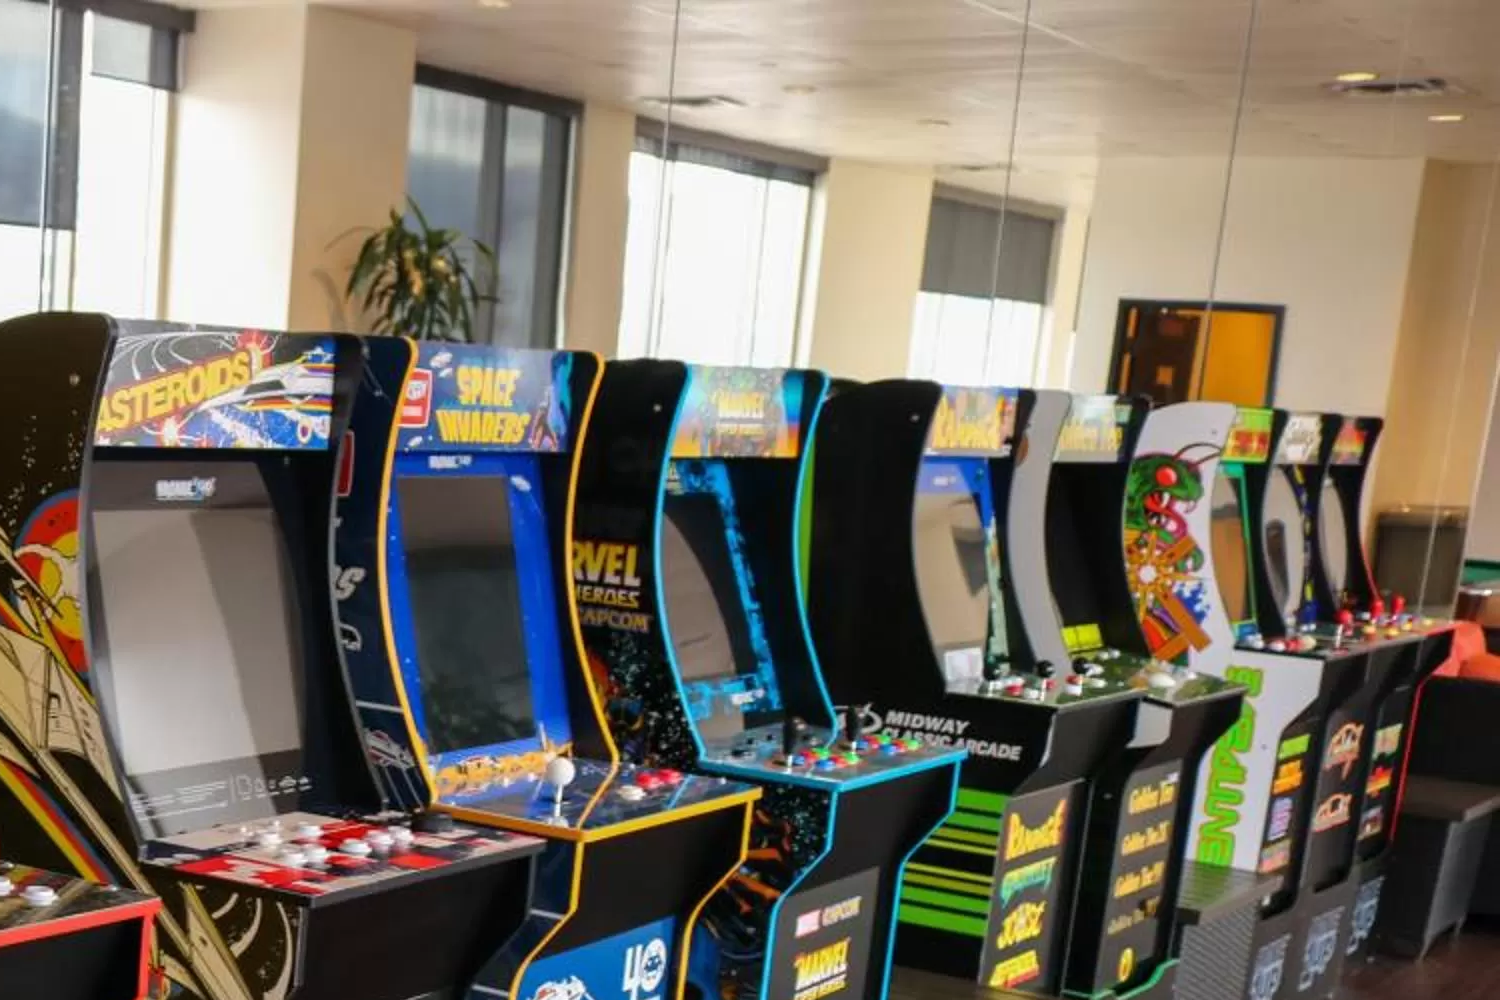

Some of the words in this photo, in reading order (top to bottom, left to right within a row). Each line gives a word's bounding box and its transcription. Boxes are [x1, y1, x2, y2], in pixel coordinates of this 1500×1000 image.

[97, 350, 250, 434] ASTEROIDS
[456, 365, 523, 406] SPACE
[435, 410, 531, 444] INVADERS
[572, 541, 641, 587] RVEL
[577, 585, 640, 609] EROES
[579, 606, 649, 633] APCOM
[885, 709, 970, 735] MIDWAY
[952, 739, 1023, 762] ARCADE
